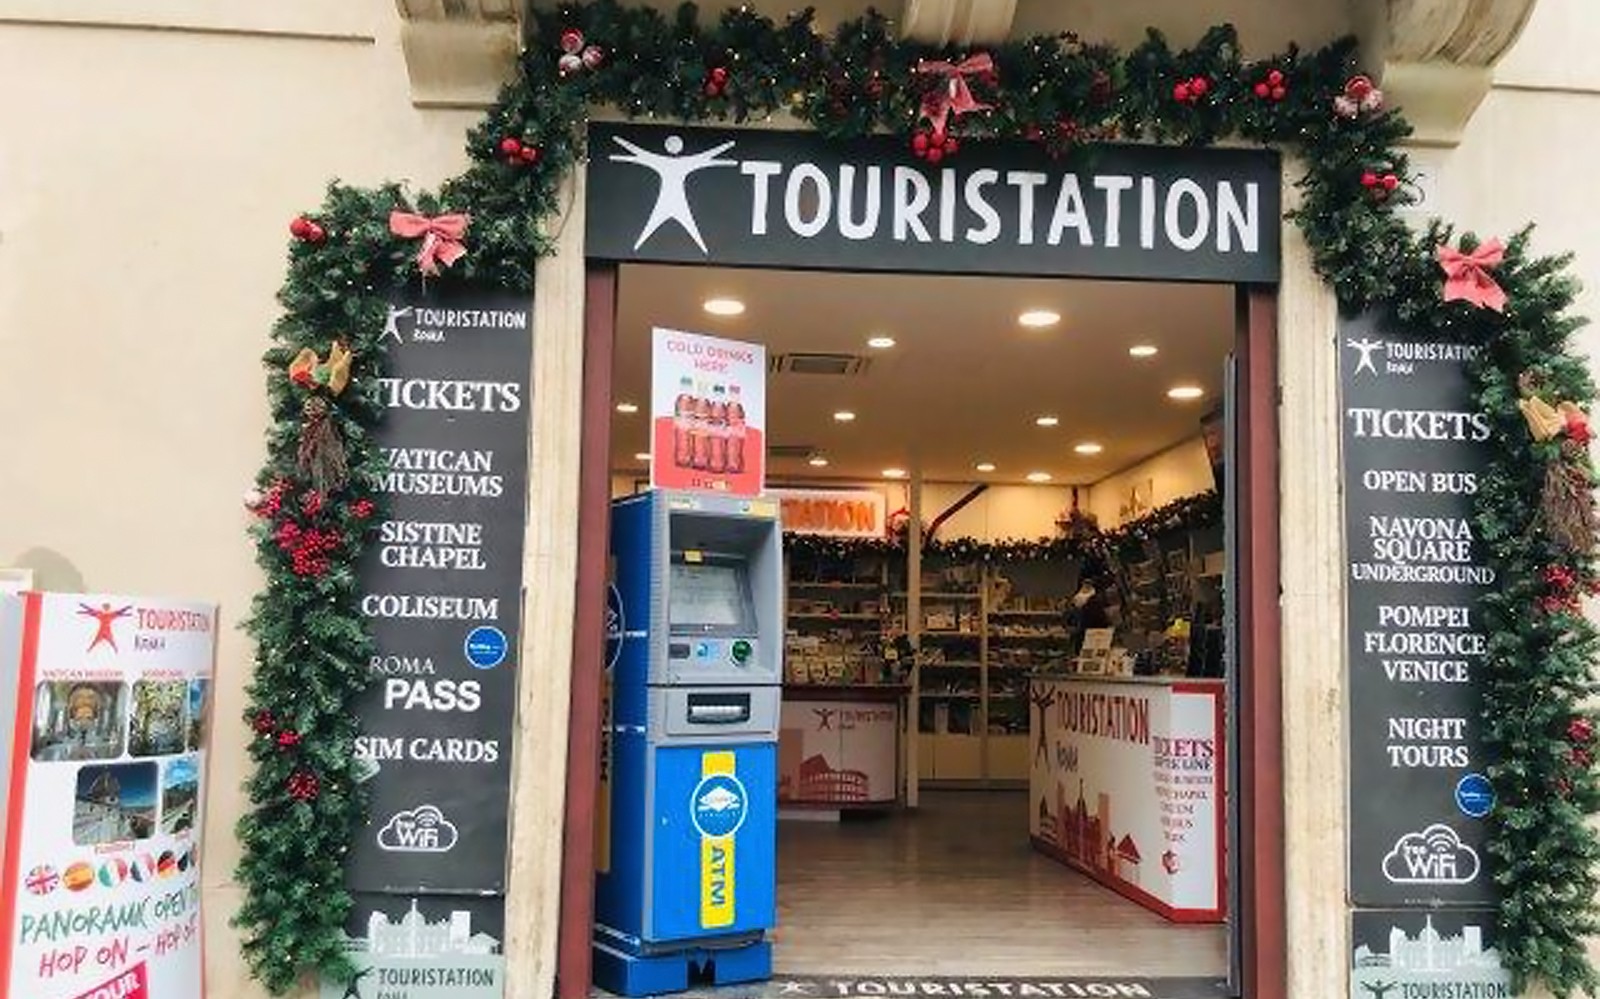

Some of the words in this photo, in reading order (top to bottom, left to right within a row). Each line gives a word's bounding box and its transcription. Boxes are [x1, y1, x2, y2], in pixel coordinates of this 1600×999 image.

[740, 161, 1259, 252] TOURISTATION
[415, 308, 526, 329] TOURISTATION
[1386, 342, 1484, 361] TOURISTATIO
[1348, 408, 1491, 441] TICKETS
[380, 448, 493, 471] VATICAN
[370, 472, 503, 496] MUSEUMS
[1363, 470, 1426, 492] OPEN
[1431, 472, 1477, 494] BUS
[380, 521, 482, 545] SISTINE
[1369, 515, 1474, 541] NAVONA
[380, 547, 486, 569] CHAPEL
[1373, 538, 1471, 565] SQUARE
[1352, 562, 1495, 585] UNDERGROUND
[361, 595, 499, 620] COLISEUM
[1378, 605, 1470, 627] POMPEI
[1364, 631, 1486, 655] FLORENCE
[369, 655, 436, 675] ROMA
[1382, 659, 1470, 683] VENICE
[384, 678, 482, 712] PASS
[1057, 691, 1149, 745] TOURISTATION
[1388, 717, 1466, 740] NIGHT
[354, 736, 404, 761] SIM
[409, 738, 499, 762] CARDS
[1387, 745, 1470, 768] TOURS
[710, 846, 725, 907] ATM
[1404, 853, 1457, 878] WiFi
[39, 944, 88, 979] HOP
[96, 936, 130, 970] ON
[378, 967, 494, 987] TOURISTATION
[836, 980, 1151, 998] TOURISTATION
